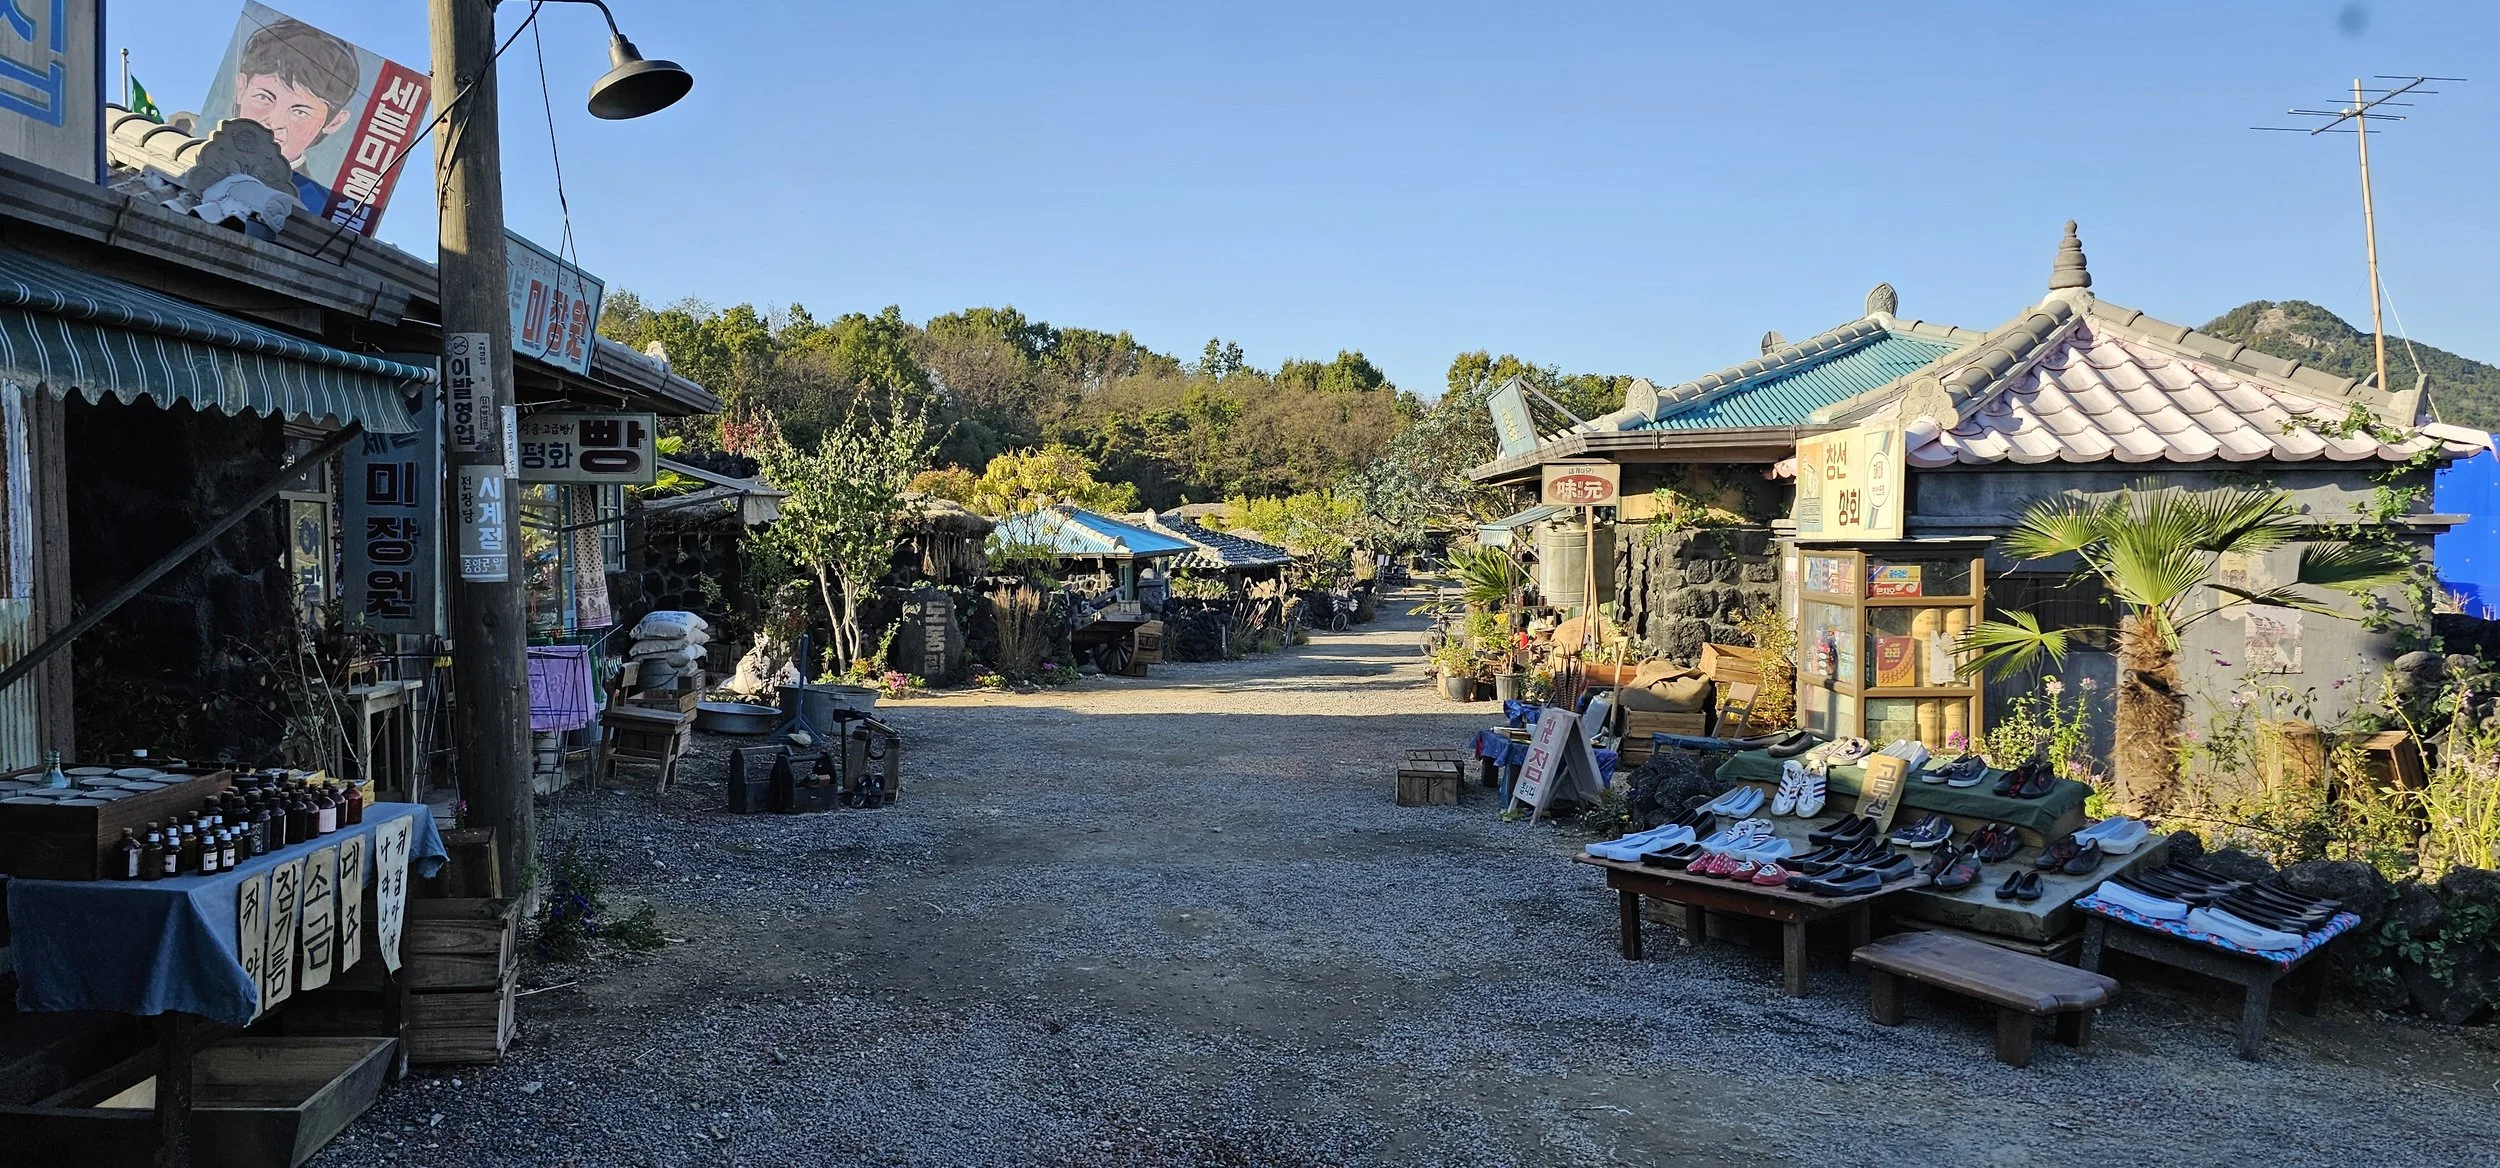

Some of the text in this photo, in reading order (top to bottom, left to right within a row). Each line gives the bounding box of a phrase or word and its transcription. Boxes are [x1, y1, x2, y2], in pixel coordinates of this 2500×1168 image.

[521, 279, 590, 362] 미장원
[451, 357, 475, 446] 이발영업
[521, 441, 573, 469] 평화
[578, 420, 647, 473] 빵
[1826, 441, 1847, 480] 창선
[366, 461, 420, 619] 미장원
[478, 476, 502, 550] 시계점
[464, 558, 503, 573] 중앙로 앞
[1524, 747, 1549, 784] 점
[1864, 763, 1897, 819] 고무신
[265, 864, 299, 999] 참기름
[303, 863, 333, 970] 소금
[341, 842, 360, 956] 대추
